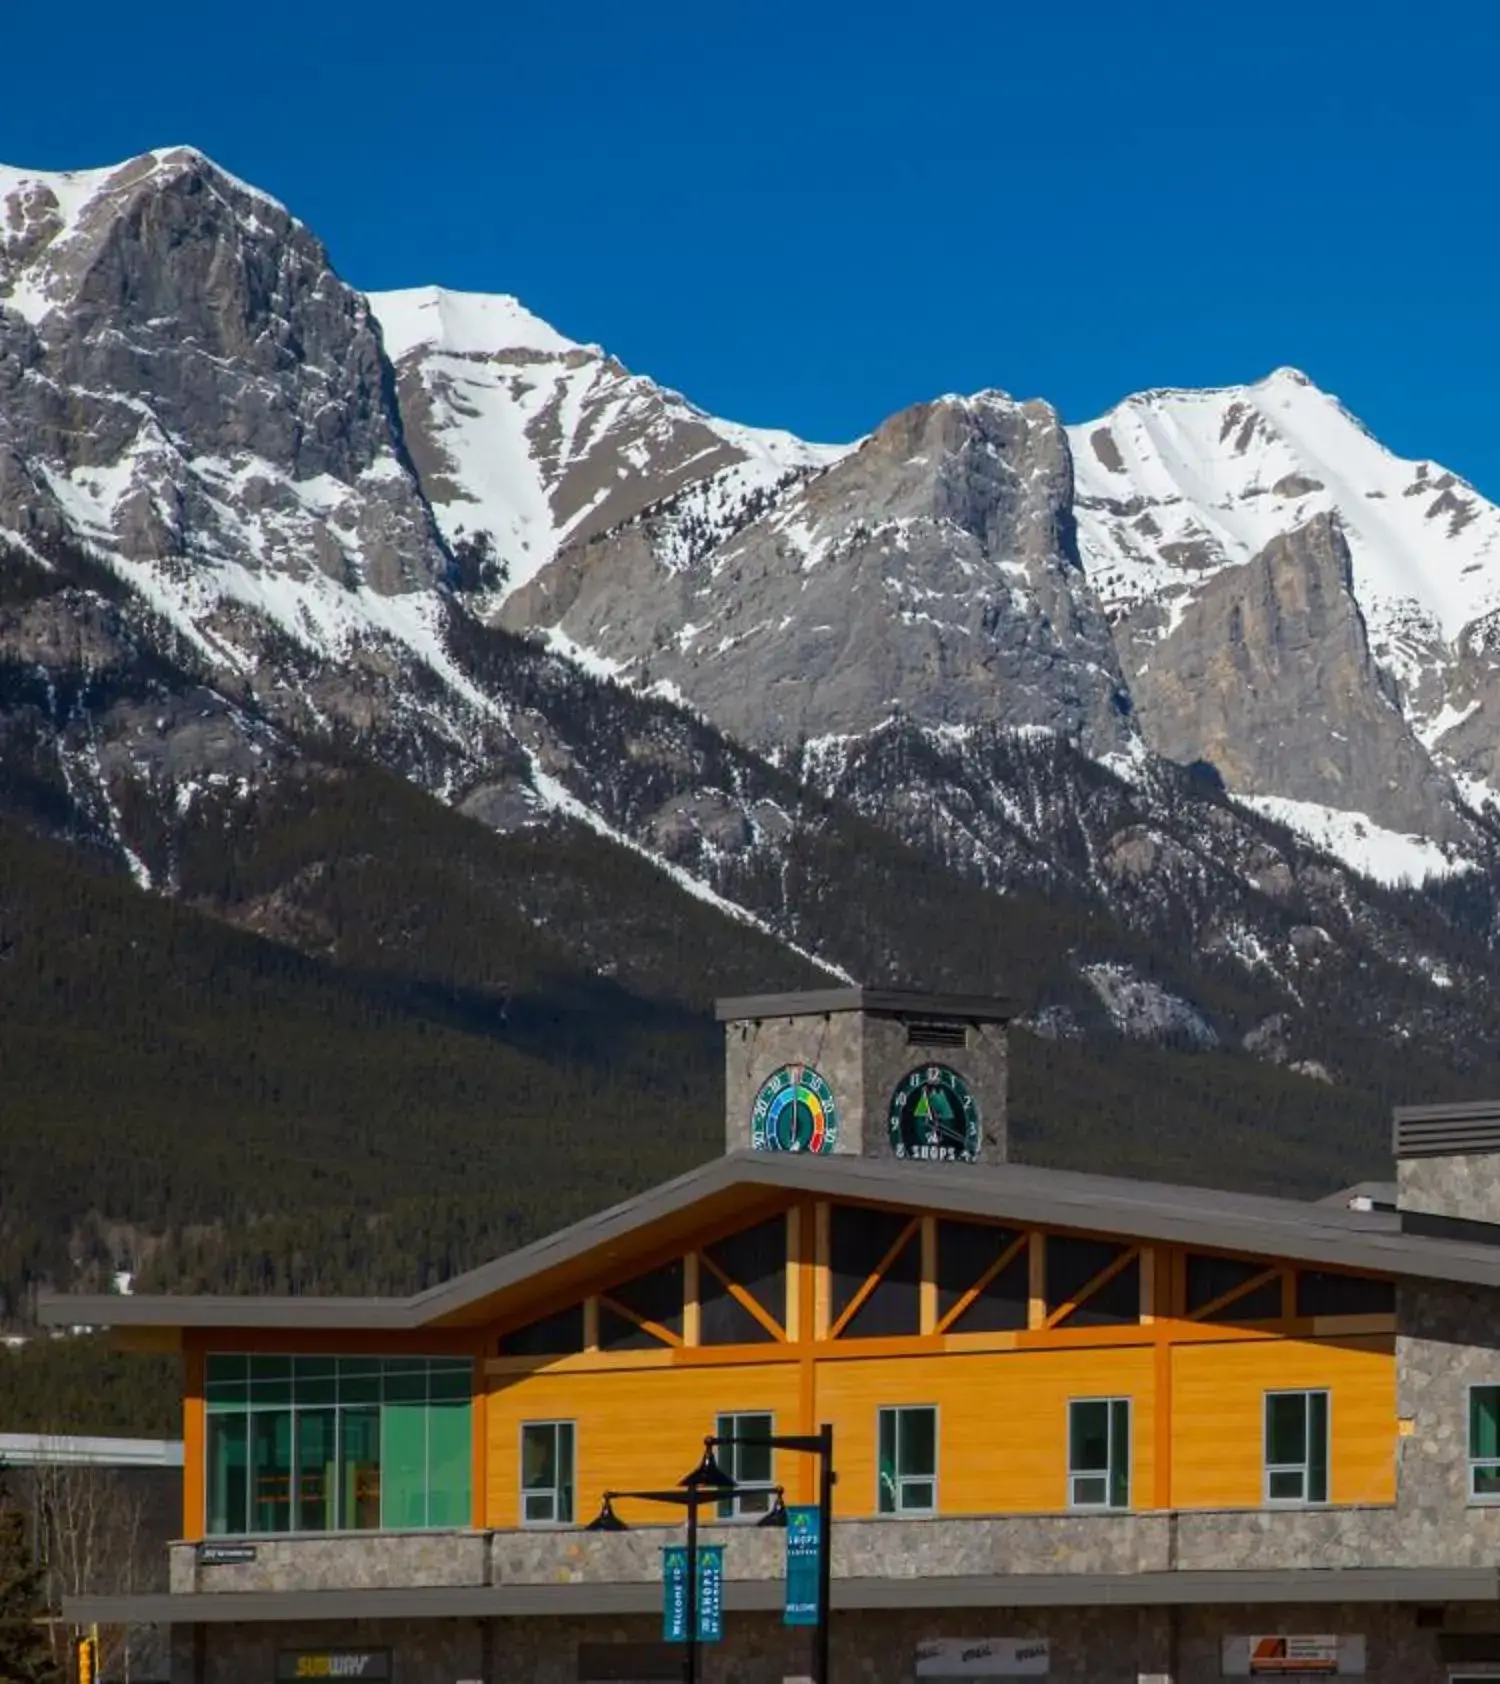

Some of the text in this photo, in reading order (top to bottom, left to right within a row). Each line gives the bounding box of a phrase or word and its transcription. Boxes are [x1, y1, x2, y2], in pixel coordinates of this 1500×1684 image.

[962, 1095, 972, 1109] 2
[890, 1116, 900, 1131] 9
[911, 1144, 956, 1161] SHOPS
[701, 1568, 713, 1615] SHOPS
[672, 1585, 683, 1635] WELCOME
[295, 1654, 369, 1678] SUBWAY
